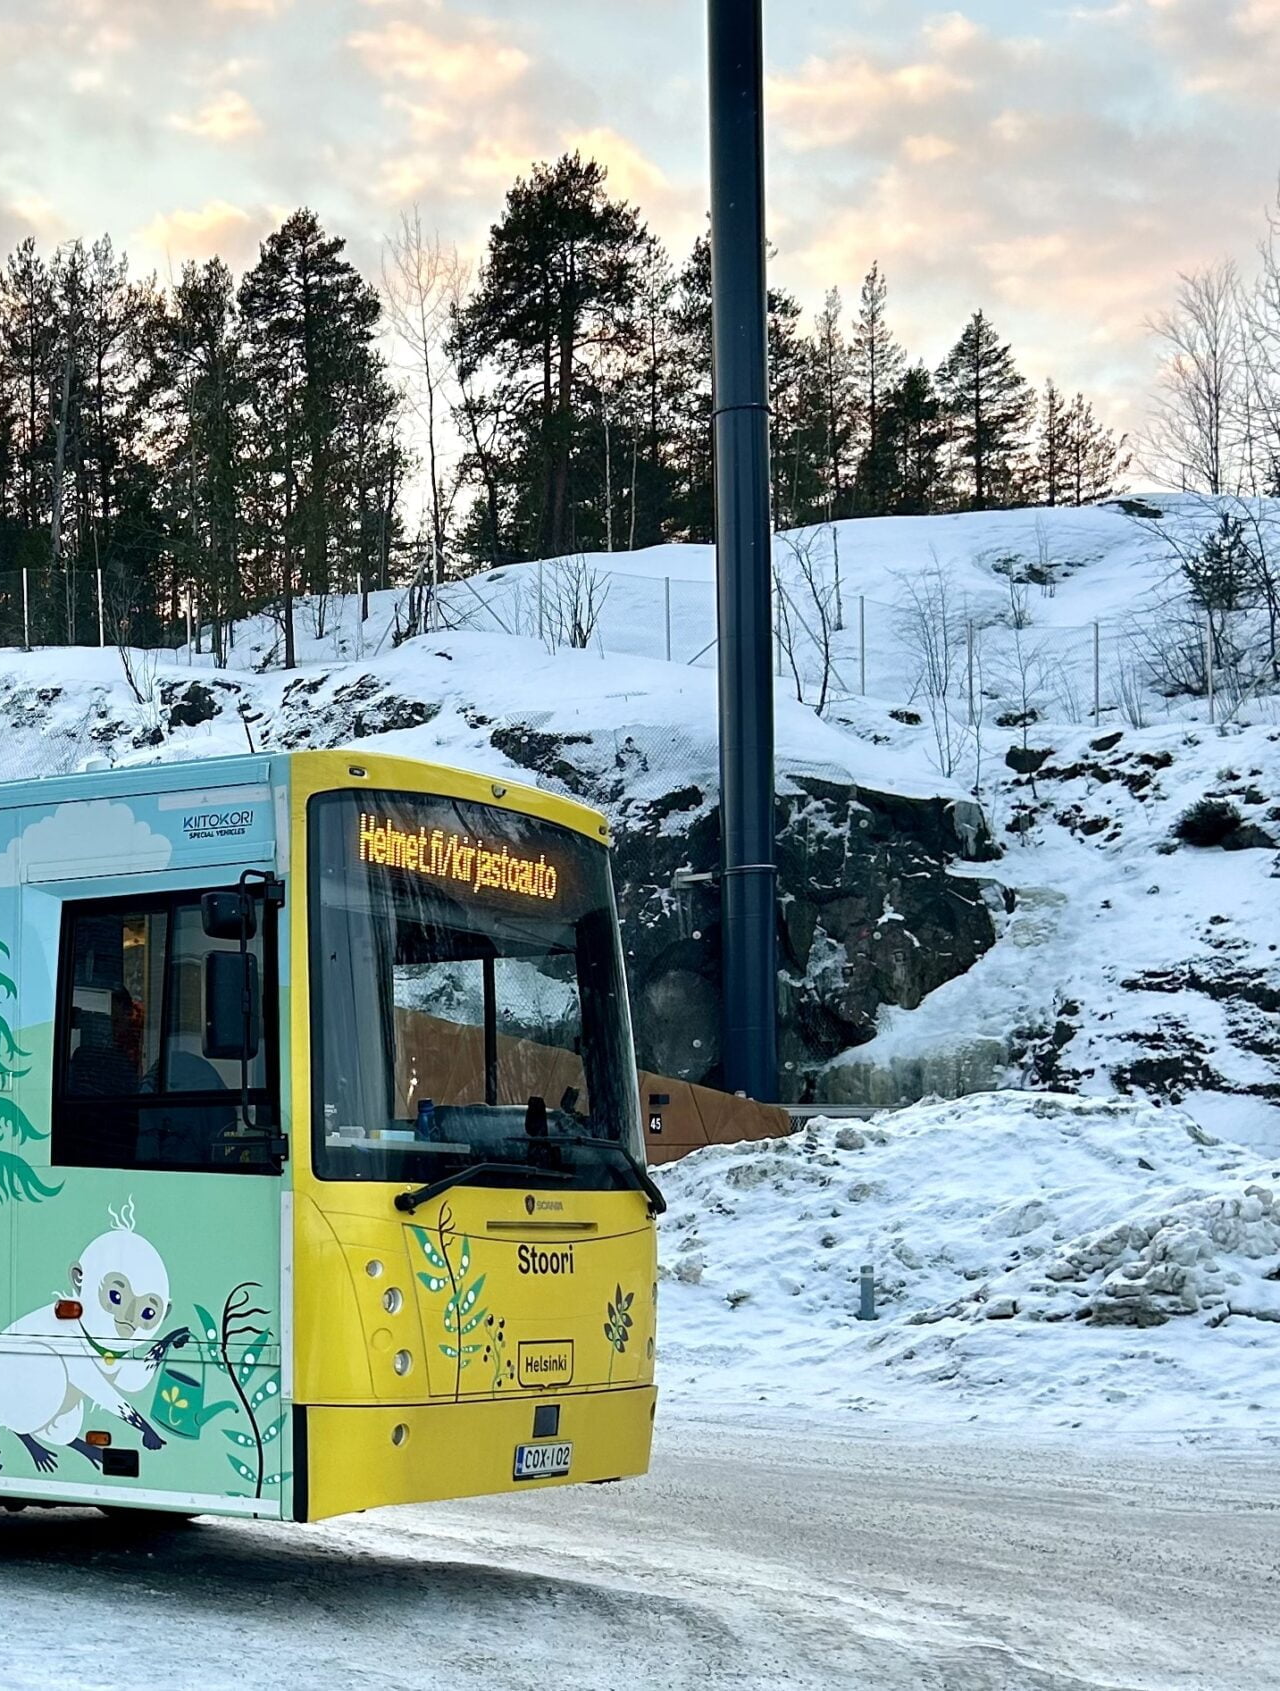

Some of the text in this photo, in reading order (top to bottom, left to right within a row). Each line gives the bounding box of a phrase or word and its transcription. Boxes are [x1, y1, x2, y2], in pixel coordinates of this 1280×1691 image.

[183, 810, 254, 829] KIITOKORI
[189, 828, 246, 839] SPECIAL VEHICLES
[359, 813, 558, 900] Helmet.fi/kirjastoauto
[650, 1117, 661, 1130] 45
[518, 1244, 574, 1274] Stoori
[525, 1354, 567, 1373] Helsinki
[525, 1446, 570, 1469] COX-102
